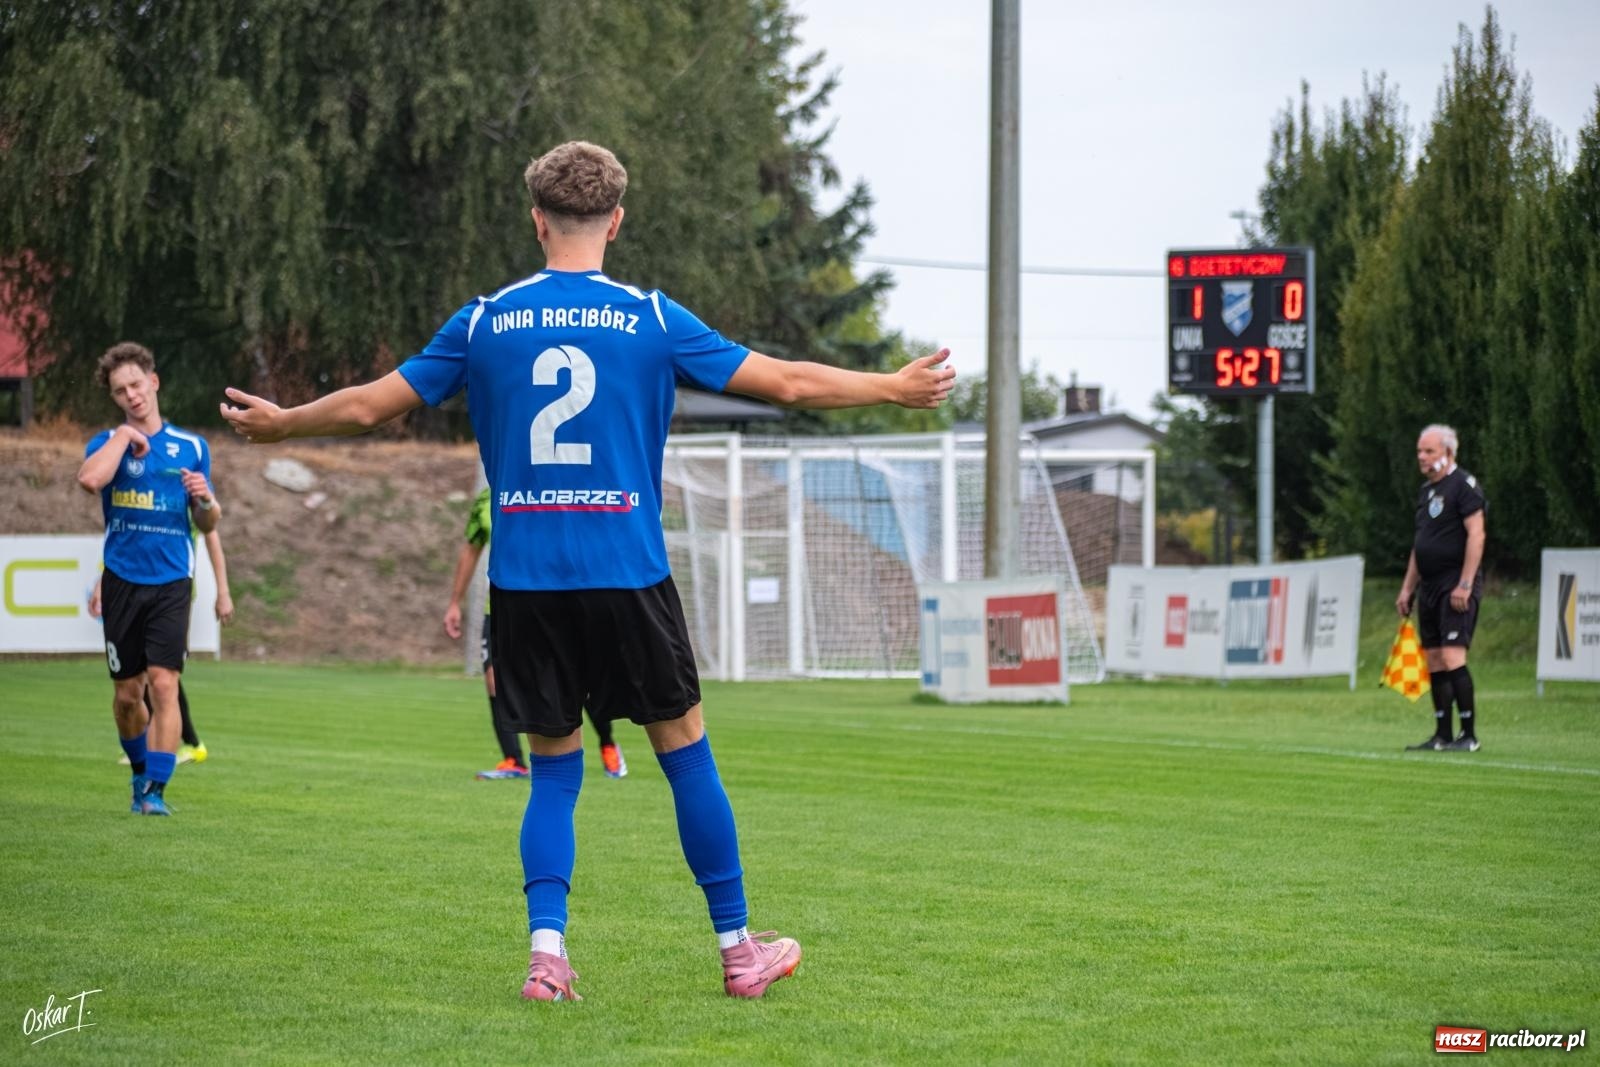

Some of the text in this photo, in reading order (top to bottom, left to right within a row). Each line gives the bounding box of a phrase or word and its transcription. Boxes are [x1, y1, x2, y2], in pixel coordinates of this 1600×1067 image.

[492, 304, 640, 334] UNIA RACIBÓRZ
[1193, 285, 1203, 320] 1
[1284, 281, 1303, 320] 0
[1216, 348, 1281, 387] 5:27
[530, 345, 596, 465] 2
[106, 641, 121, 673] 8
